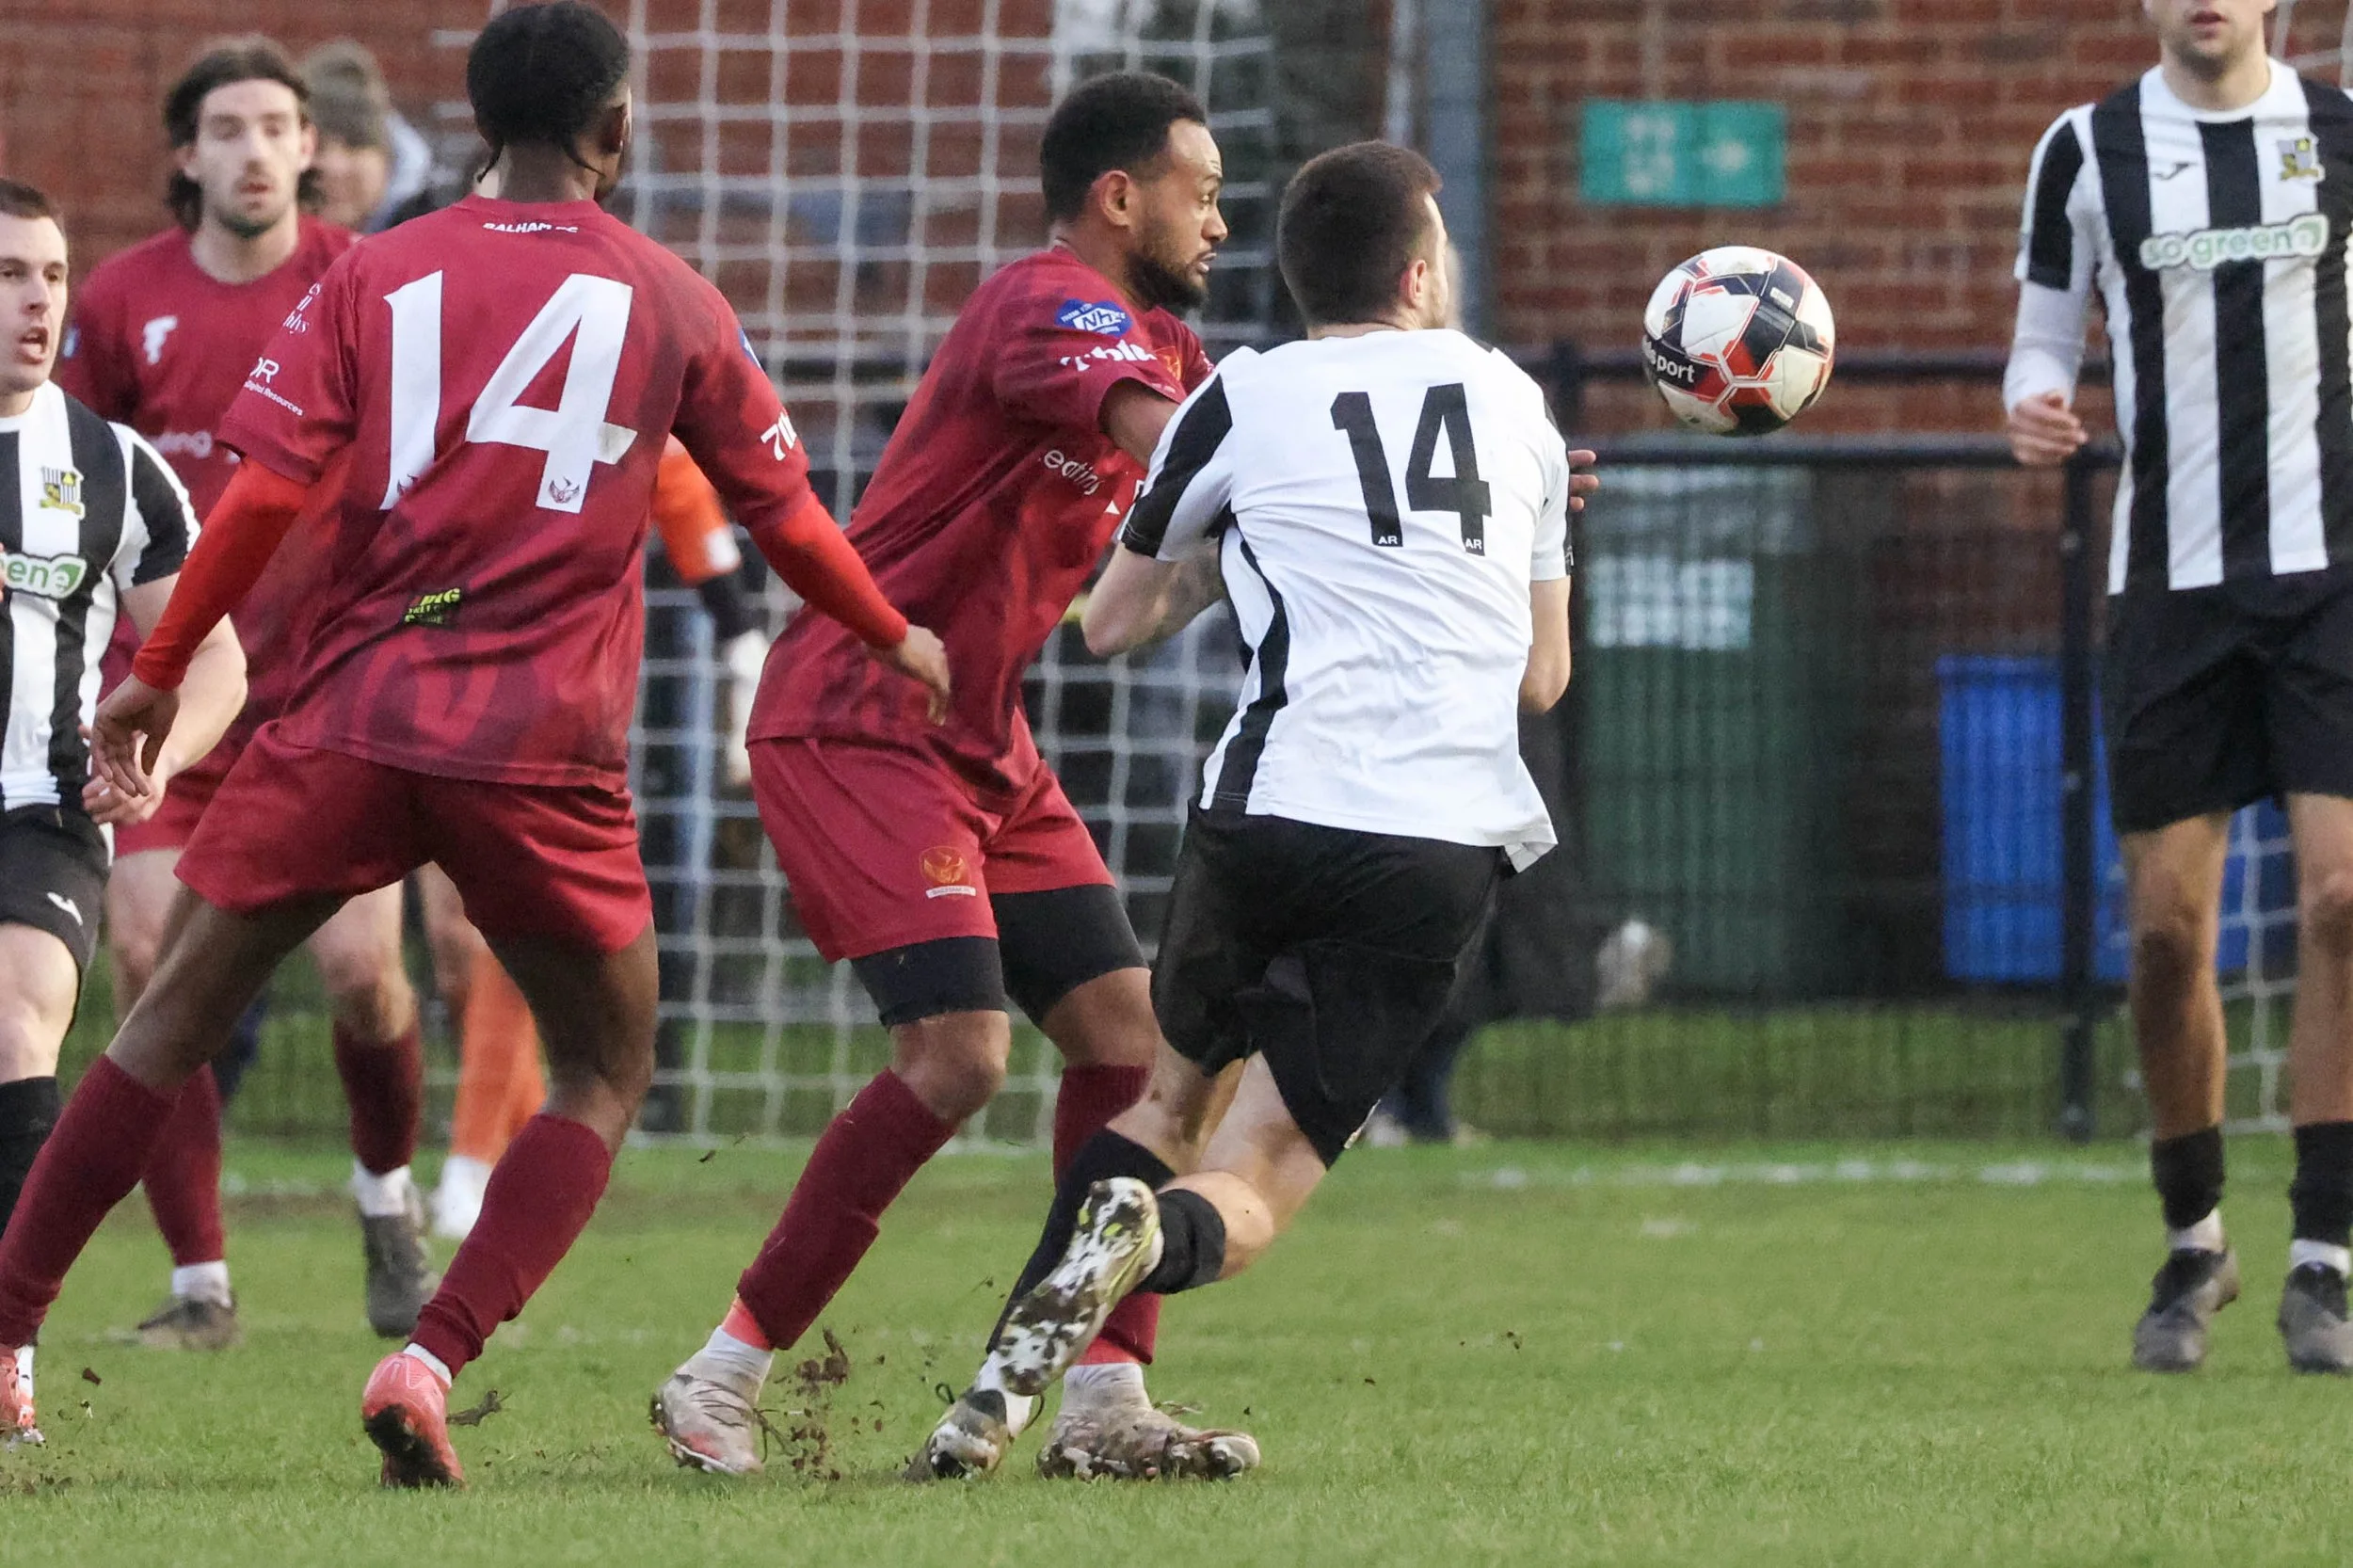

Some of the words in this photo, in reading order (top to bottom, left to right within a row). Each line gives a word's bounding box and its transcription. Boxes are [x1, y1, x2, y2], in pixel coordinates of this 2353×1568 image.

[2191, 229, 2293, 265] green
[264, 388, 303, 416] Resources
[379, 269, 637, 514] 14
[1330, 382, 1492, 556] 14
[1378, 535, 1399, 545] AR
[1465, 538, 1483, 550] AR
